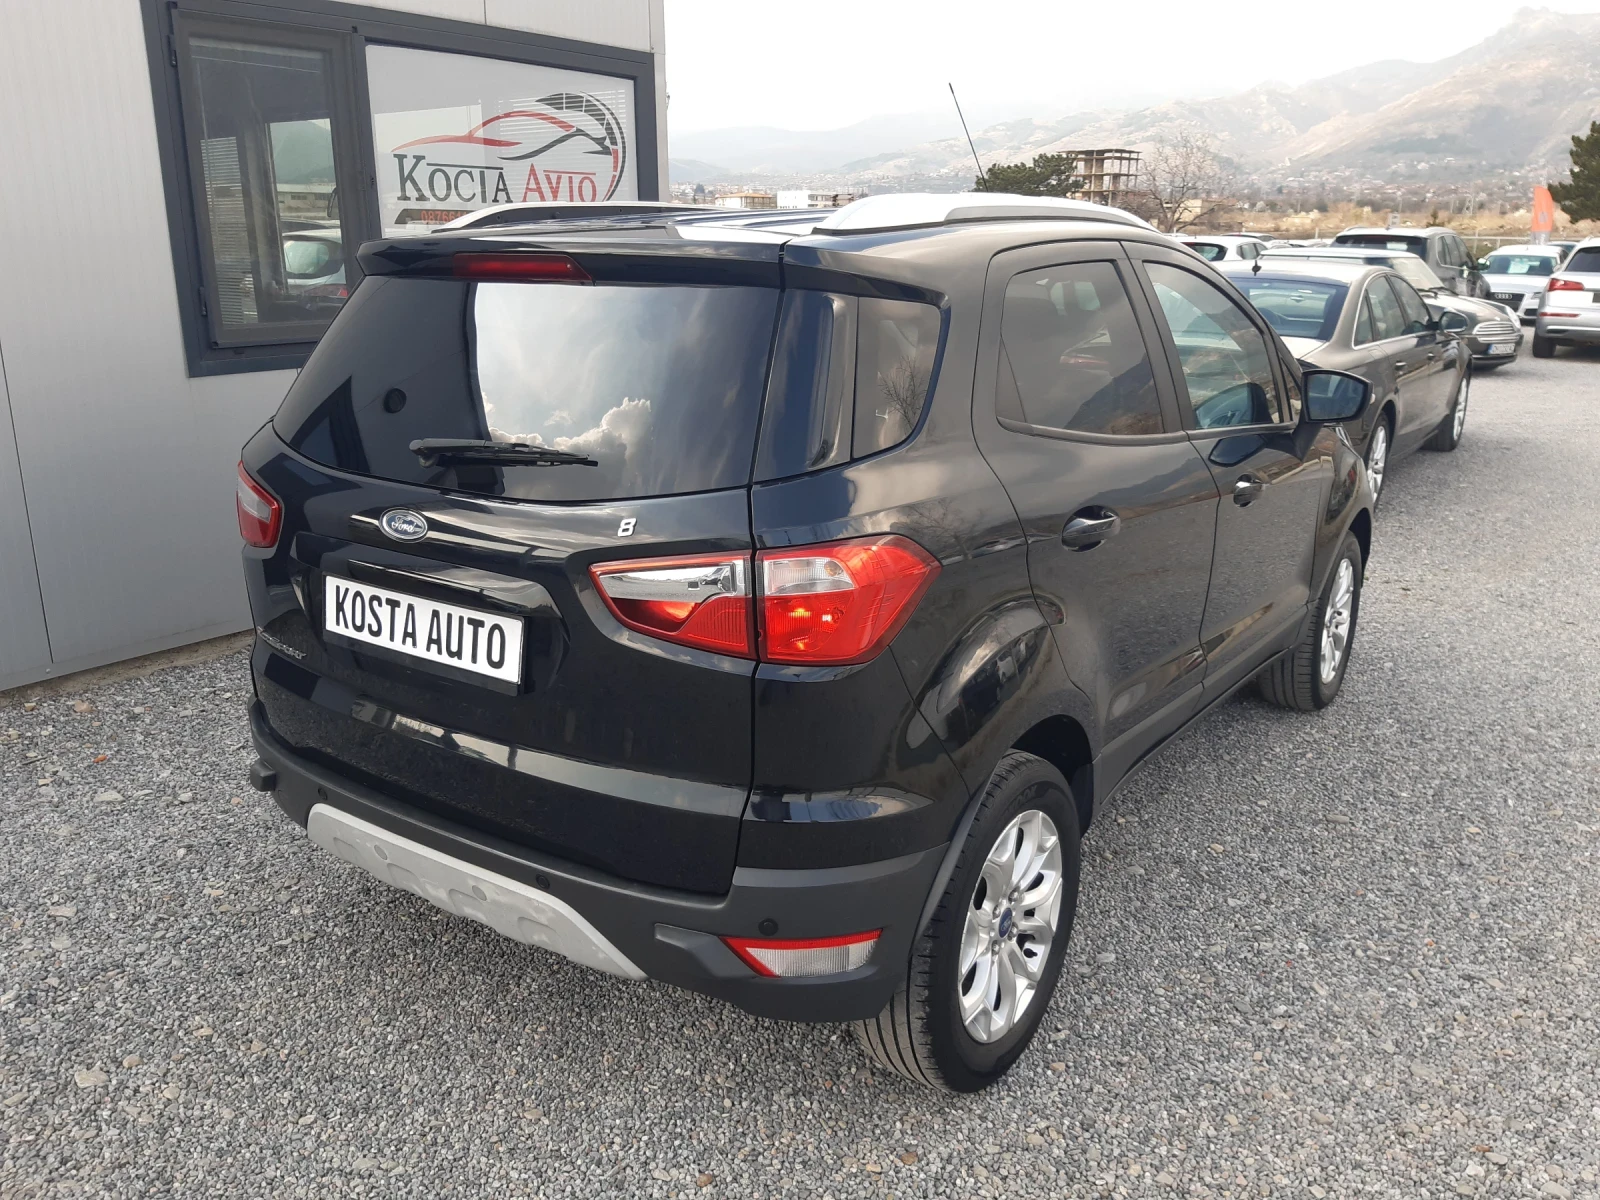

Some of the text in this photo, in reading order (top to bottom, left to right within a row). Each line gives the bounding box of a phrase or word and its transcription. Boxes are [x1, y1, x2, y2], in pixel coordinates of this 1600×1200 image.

[391, 515, 417, 533] Ford
[335, 584, 417, 648] KOSTA
[425, 609, 506, 669] AUTO
